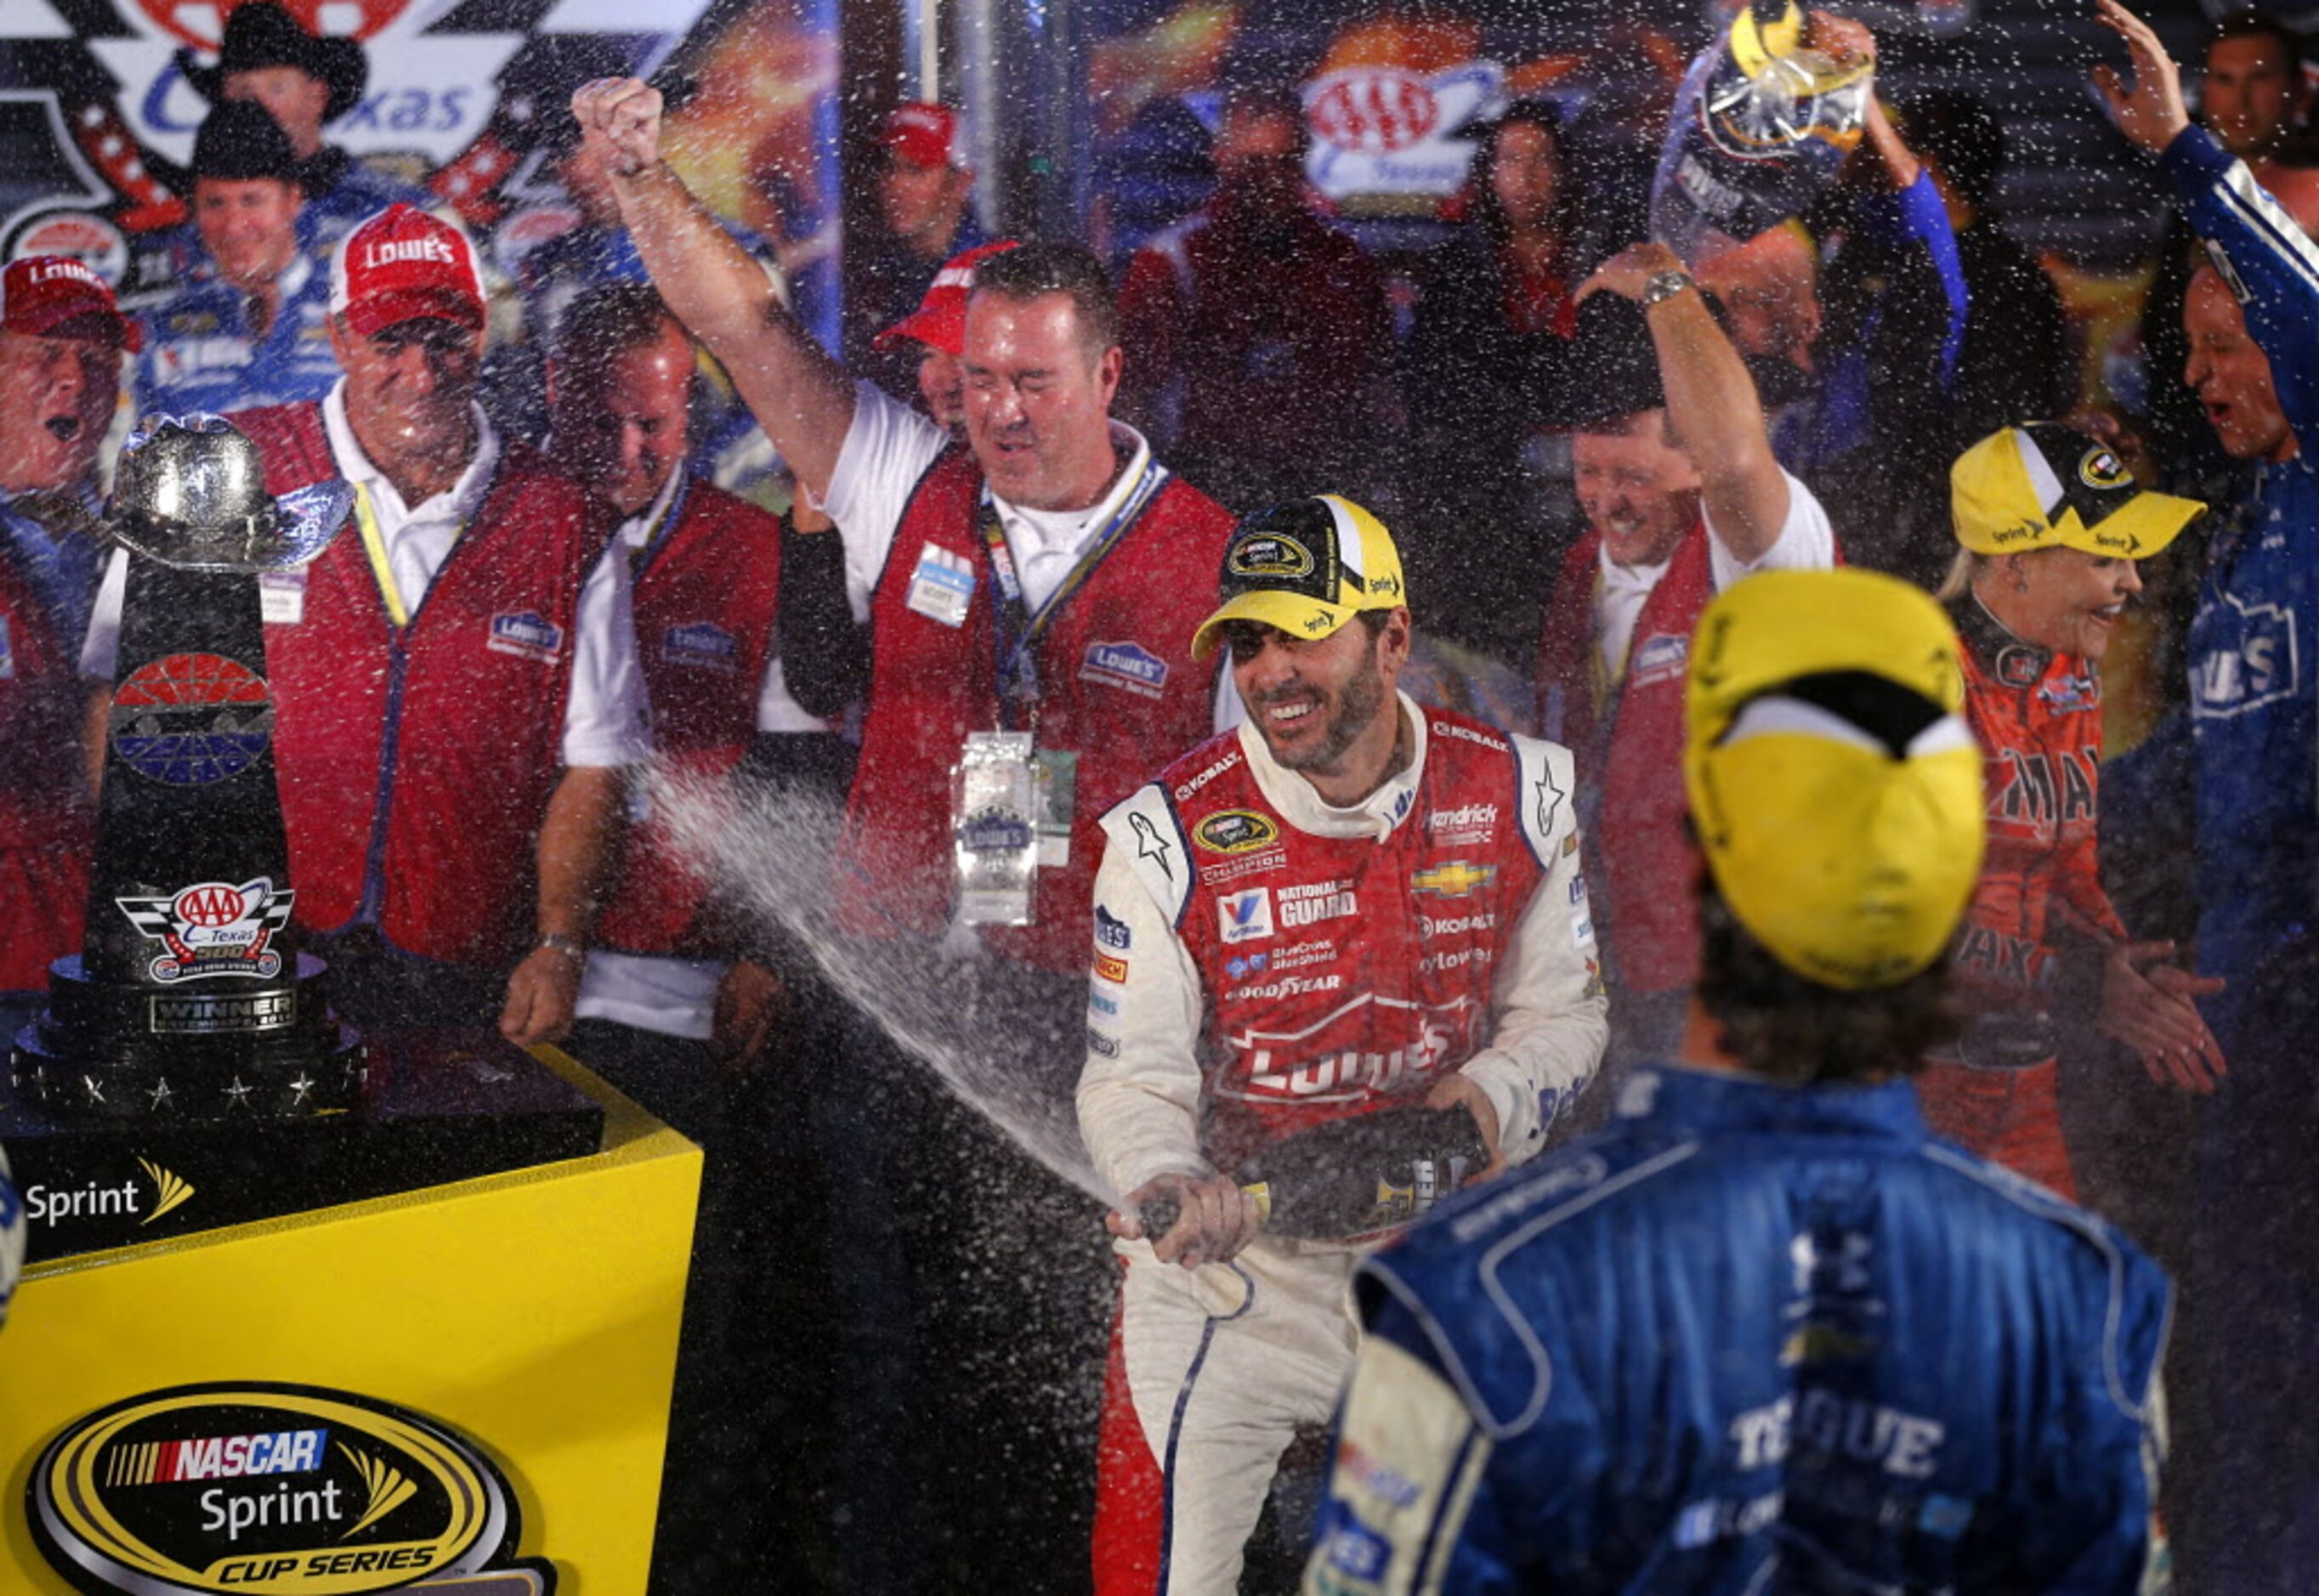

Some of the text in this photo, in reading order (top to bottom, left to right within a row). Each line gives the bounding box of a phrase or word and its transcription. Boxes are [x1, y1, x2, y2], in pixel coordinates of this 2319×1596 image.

[339, 86, 473, 133] xas
[366, 237, 454, 269] LOWE'S
[1369, 577, 1393, 593] Sprint
[1304, 615, 1328, 633] Sprint
[1203, 853, 1287, 882] CHAMPION
[182, 886, 242, 927] AAA
[1277, 880, 1339, 902] NATIONAL
[1280, 891, 1358, 928] GUARD
[1435, 914, 1495, 934] KOBALT
[211, 930, 255, 942] Texas
[158, 997, 292, 1019] WINNER
[26, 1180, 139, 1228] Sprint
[173, 1430, 318, 1480] NASCAR
[200, 1480, 343, 1541] Sprint
[218, 1546, 439, 1584] CUP SERIES
